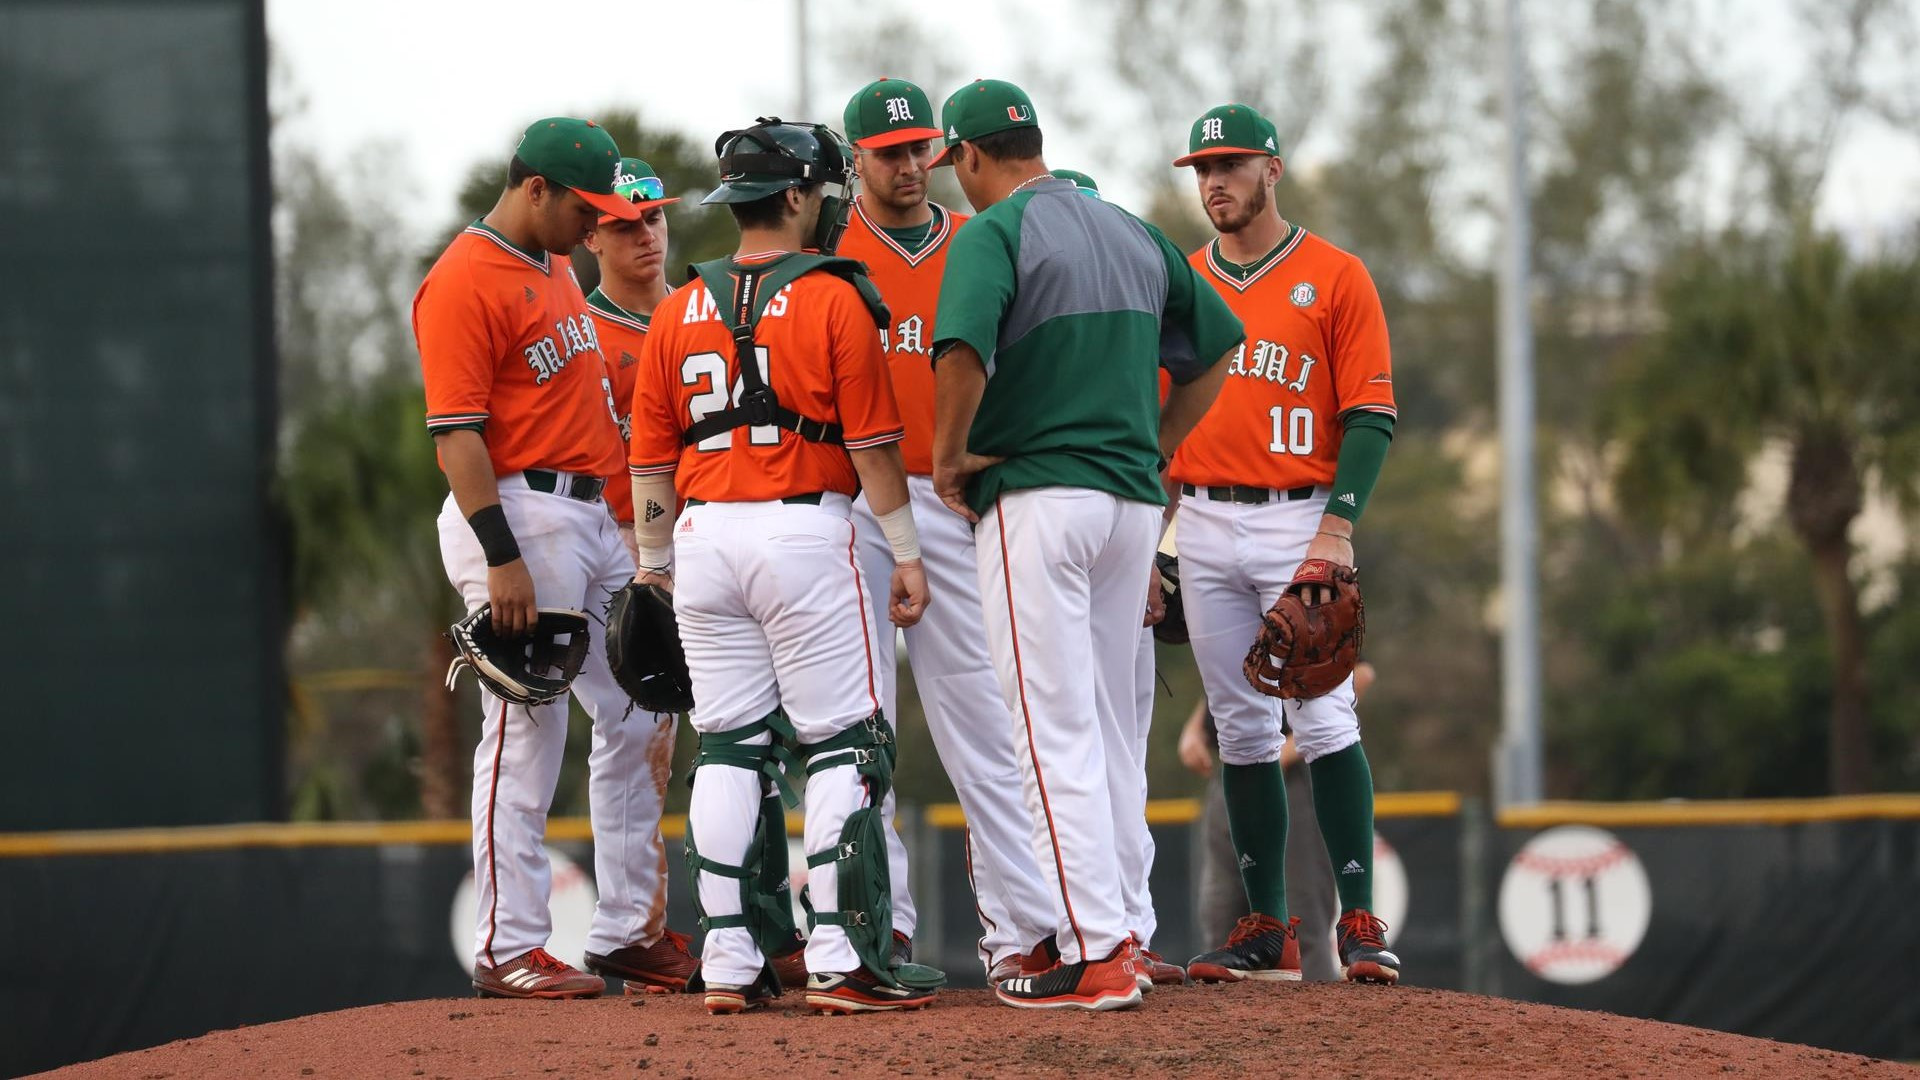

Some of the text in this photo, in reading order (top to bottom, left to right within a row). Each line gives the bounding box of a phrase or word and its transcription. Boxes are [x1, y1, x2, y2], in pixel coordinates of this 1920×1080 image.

[885, 97, 914, 125] M
[1007, 105, 1032, 122] U
[1201, 117, 1225, 144] M
[740, 274, 752, 325] PRO SERIES
[524, 313, 605, 386] MIAM
[1269, 405, 1314, 456] 10
[1549, 877, 1602, 942] 11
